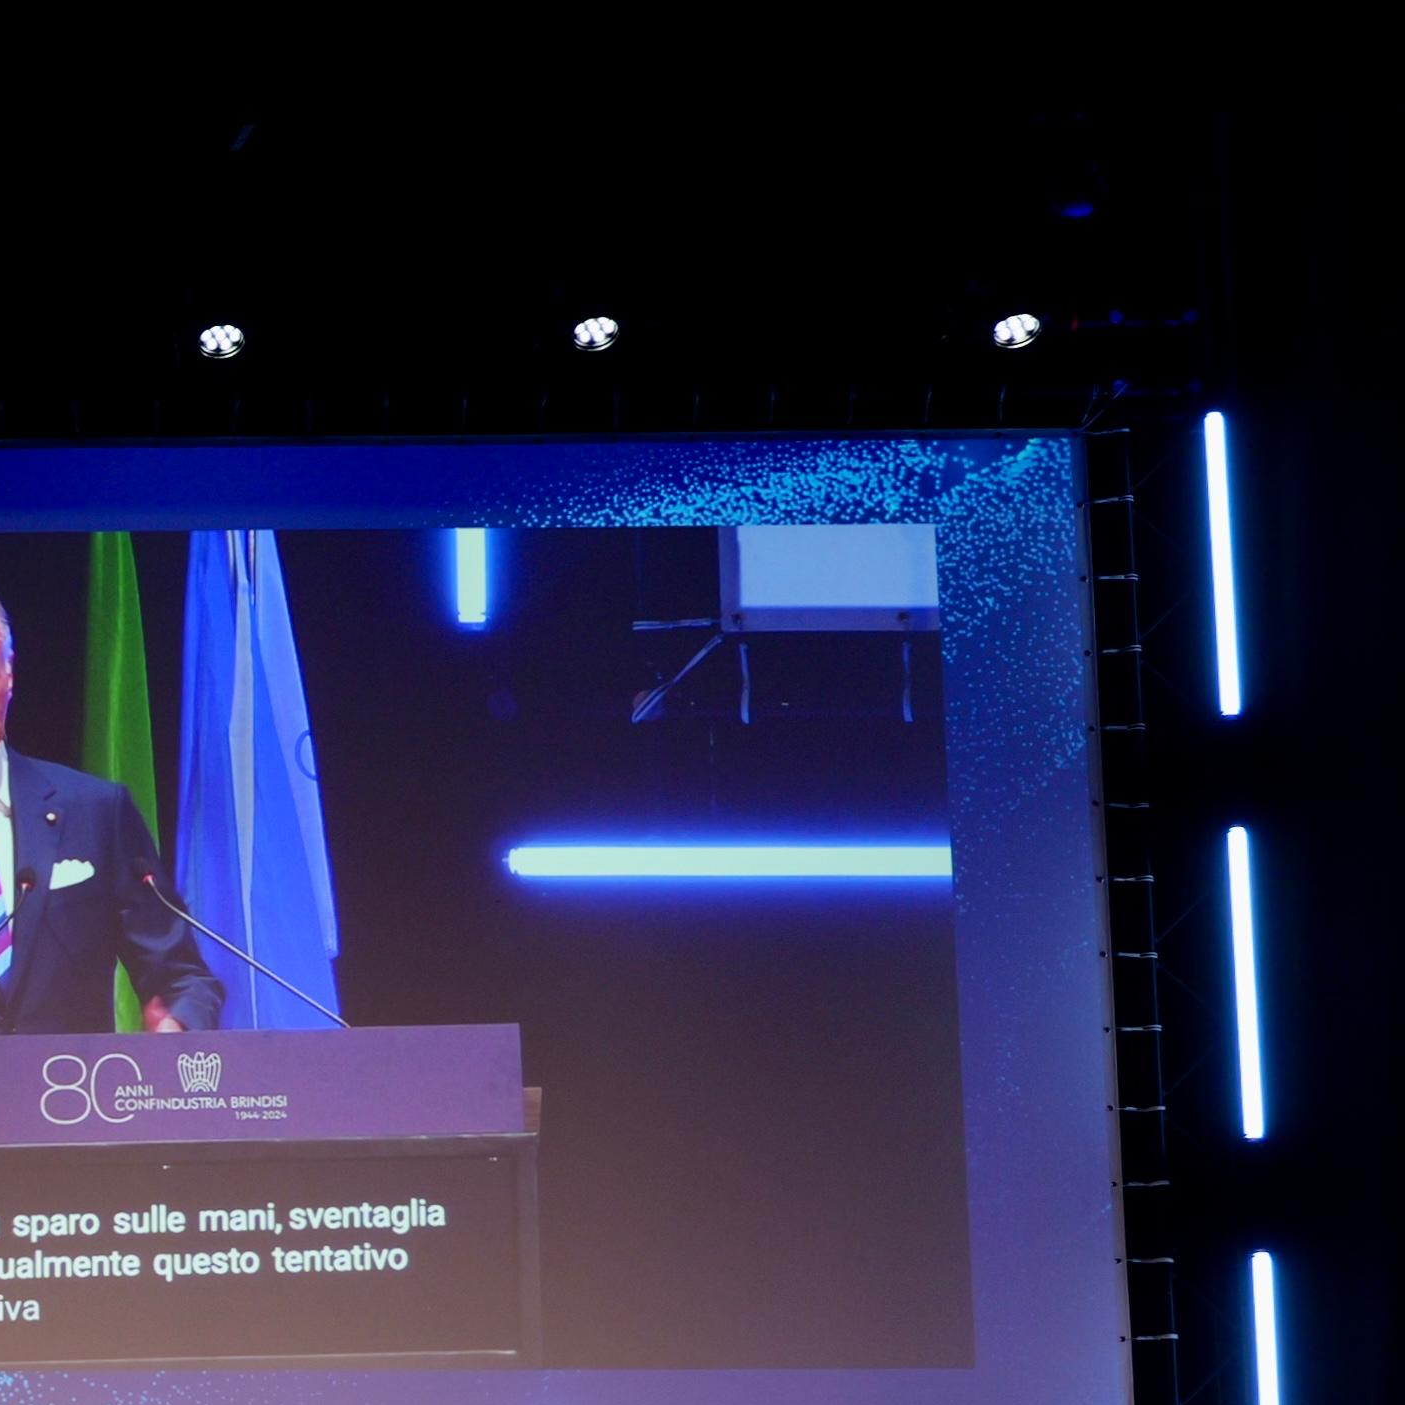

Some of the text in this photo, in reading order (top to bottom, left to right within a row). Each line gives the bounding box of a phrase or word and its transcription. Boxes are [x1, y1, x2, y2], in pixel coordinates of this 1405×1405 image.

[115, 1085, 153, 1098] ANNI
[115, 1095, 288, 1111] CONFINDUSTRIA BRINDISI
[12, 1211, 100, 1243] sparo
[113, 1204, 186, 1234] sulle
[199, 1203, 283, 1237] mani,
[289, 1199, 446, 1234] sventaglia
[153, 1248, 260, 1282] questo
[272, 1242, 408, 1273] tentativo
